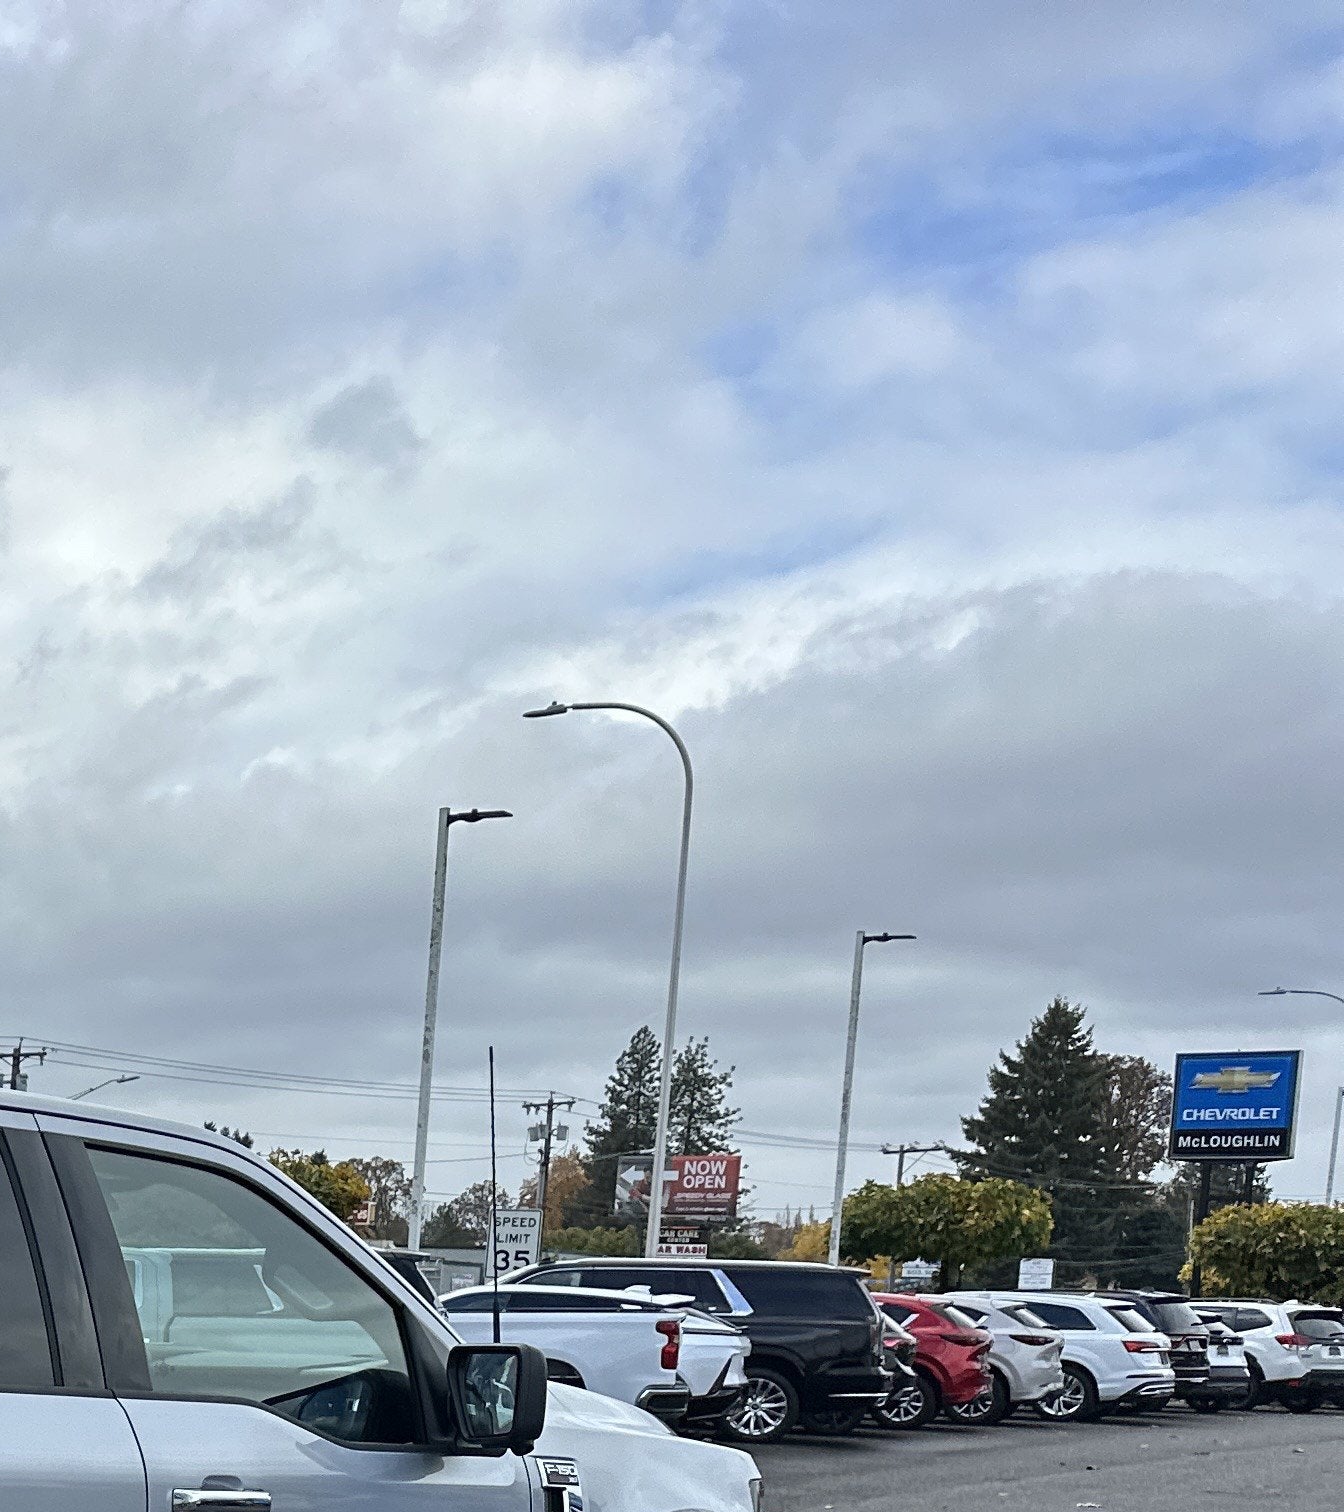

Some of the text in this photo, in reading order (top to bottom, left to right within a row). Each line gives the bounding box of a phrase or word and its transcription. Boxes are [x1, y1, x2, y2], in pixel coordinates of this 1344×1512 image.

[1182, 1107, 1281, 1120] CHEVROLET
[1178, 1134, 1281, 1148] McLOUGHLIN
[683, 1160, 727, 1175] NOW
[682, 1175, 727, 1189] OPEN
[494, 1216, 537, 1228] SPEED
[496, 1233, 531, 1244] LIMIT
[676, 1245, 706, 1254] WASH
[493, 1249, 530, 1271] 35
